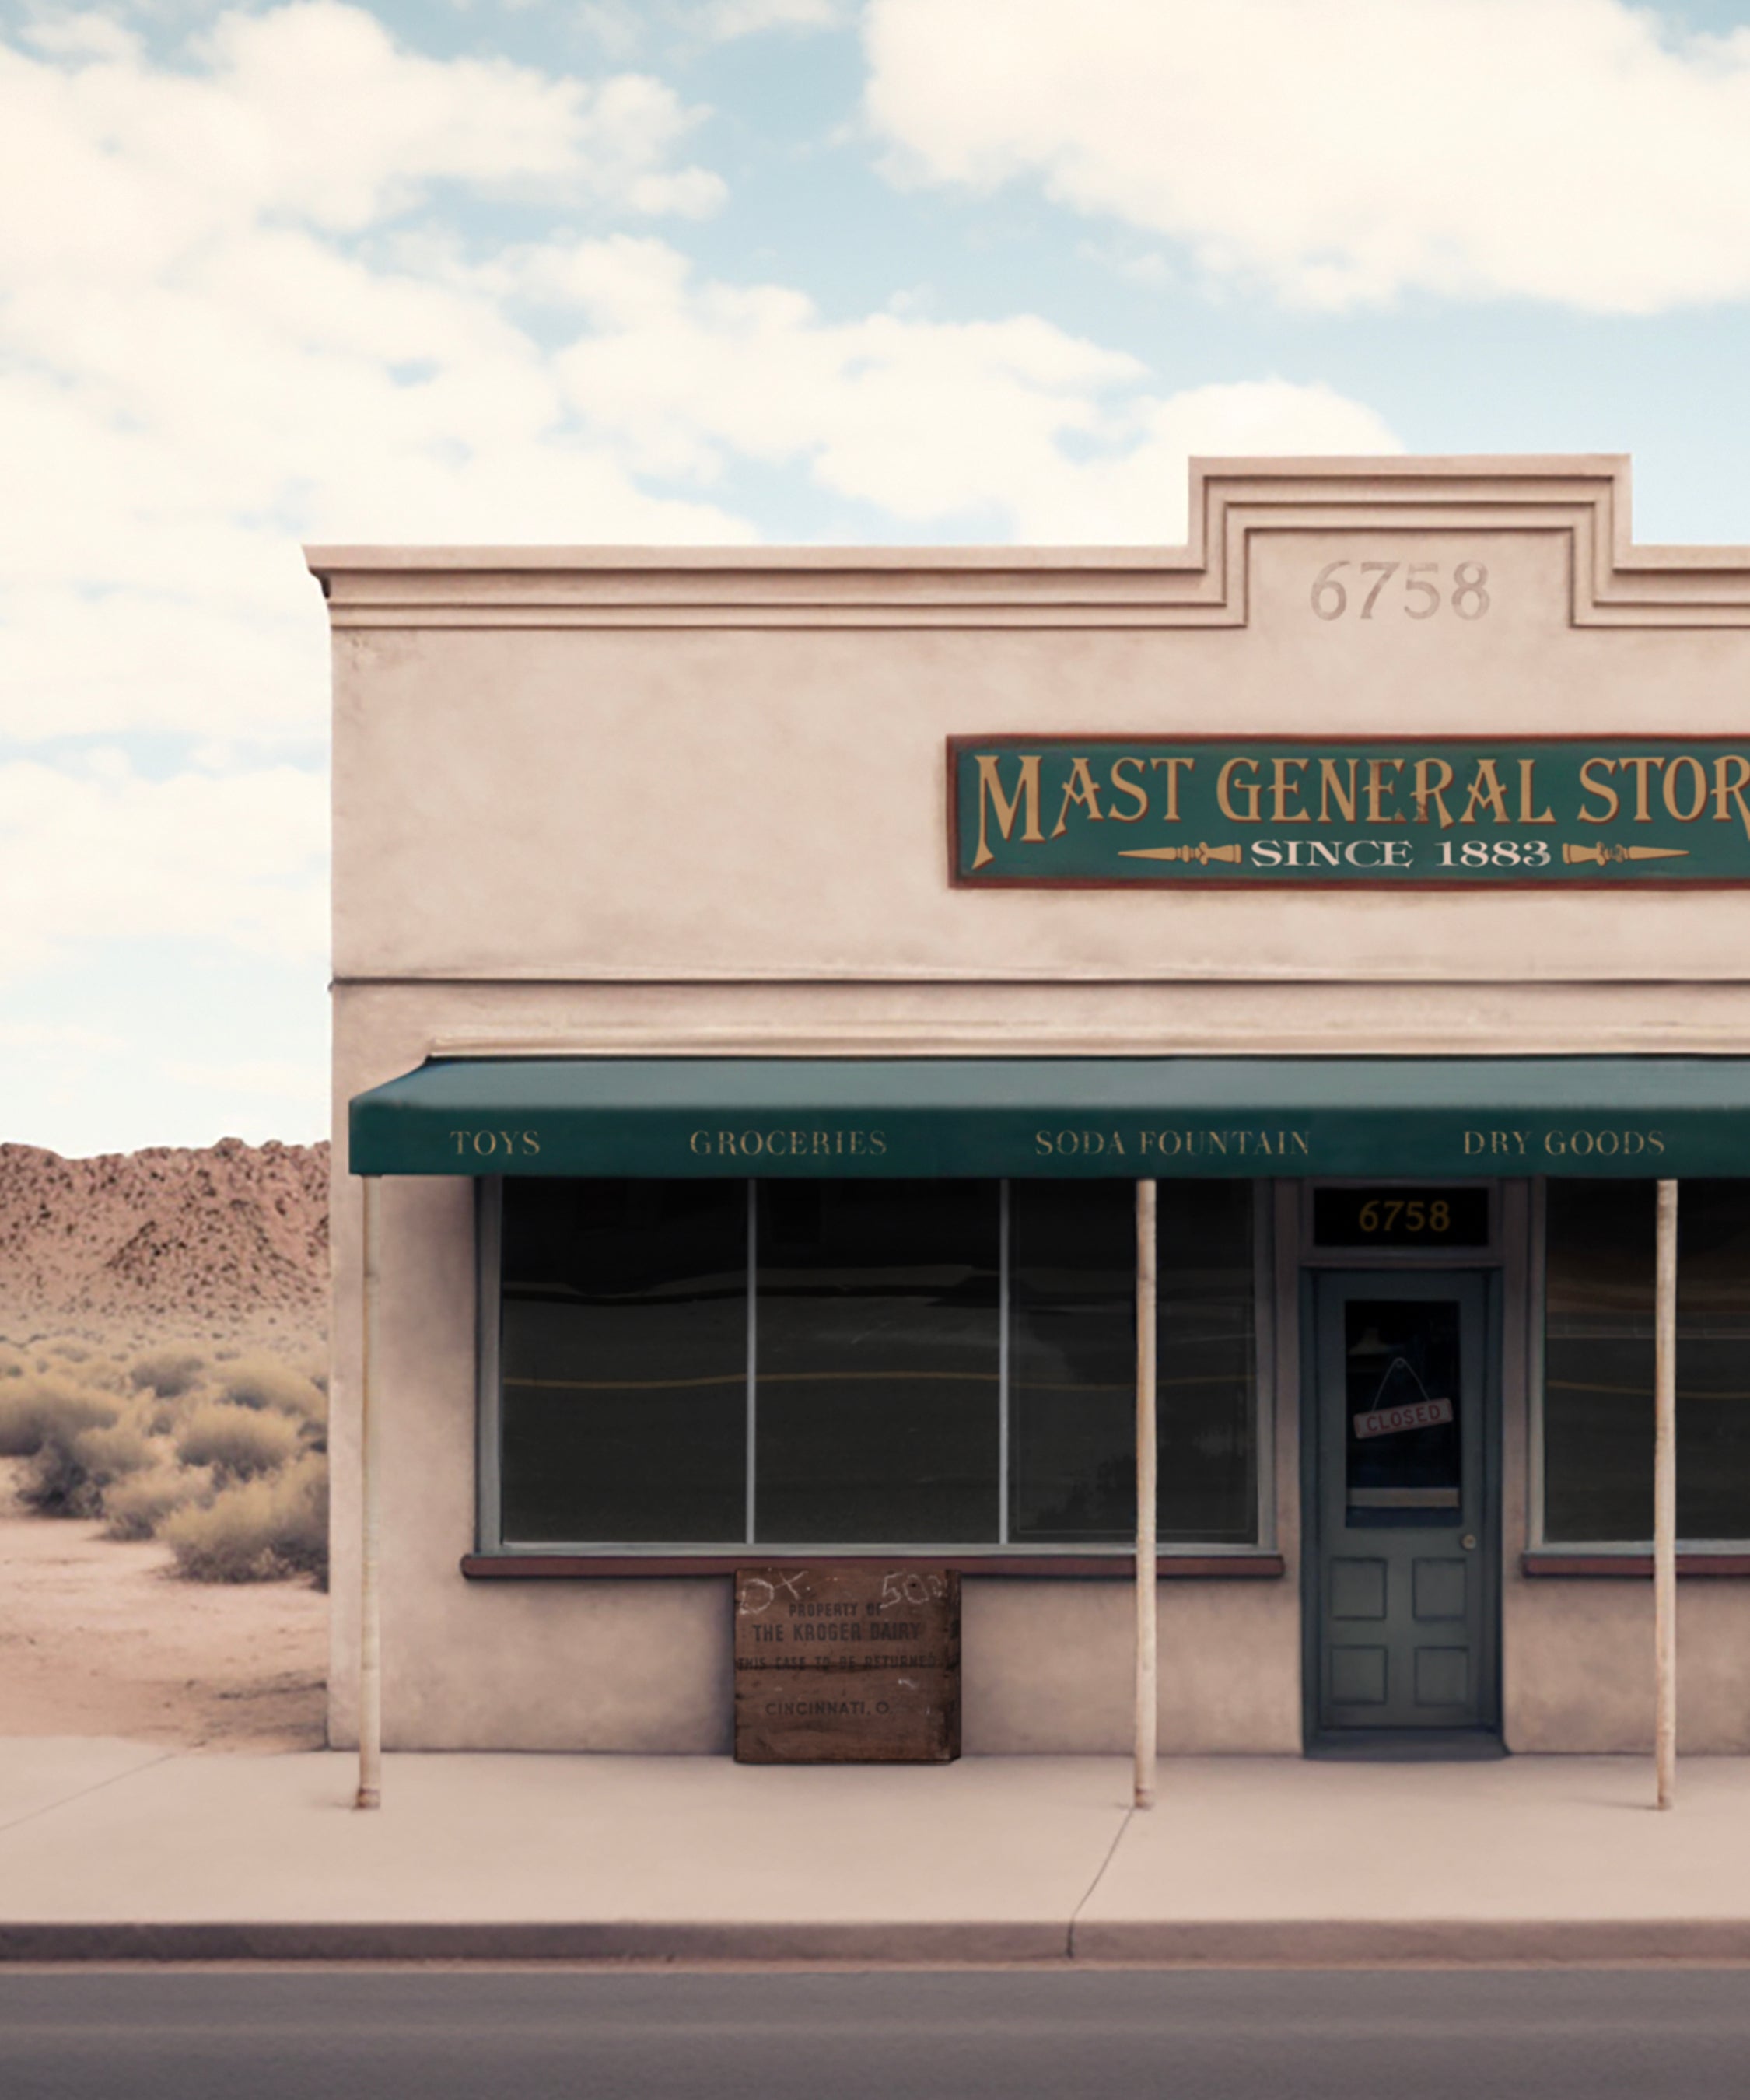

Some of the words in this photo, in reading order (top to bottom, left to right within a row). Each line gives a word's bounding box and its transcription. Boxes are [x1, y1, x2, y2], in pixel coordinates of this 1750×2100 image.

[1310, 559, 1491, 621] 6758
[972, 755, 1196, 870] MAST
[1216, 757, 1556, 830] GENERAL
[1577, 754, 1750, 842] STOR
[1251, 839, 1414, 868] SINCE
[1434, 839, 1552, 868] 1883
[450, 1130, 541, 1155] TOYS
[689, 1130, 888, 1156] GROCERIES
[1034, 1129, 1126, 1156] SODA
[1139, 1129, 1311, 1156] FOUNTAIN
[1464, 1130, 1532, 1156] DRY
[1544, 1129, 1666, 1156] GOODS
[1358, 1200, 1451, 1233] 6758
[1366, 1404, 1441, 1433] CLOSED
[789, 1603, 859, 1618] PROPERTY
[866, 1602, 882, 1616] OF
[752, 1624, 784, 1643] THE
[793, 1622, 862, 1641] KROGER
[870, 1622, 922, 1641] DAIRY
[738, 1657, 765, 1670] THIS
[815, 1656, 831, 1670] TO
[840, 1656, 857, 1669] BE
